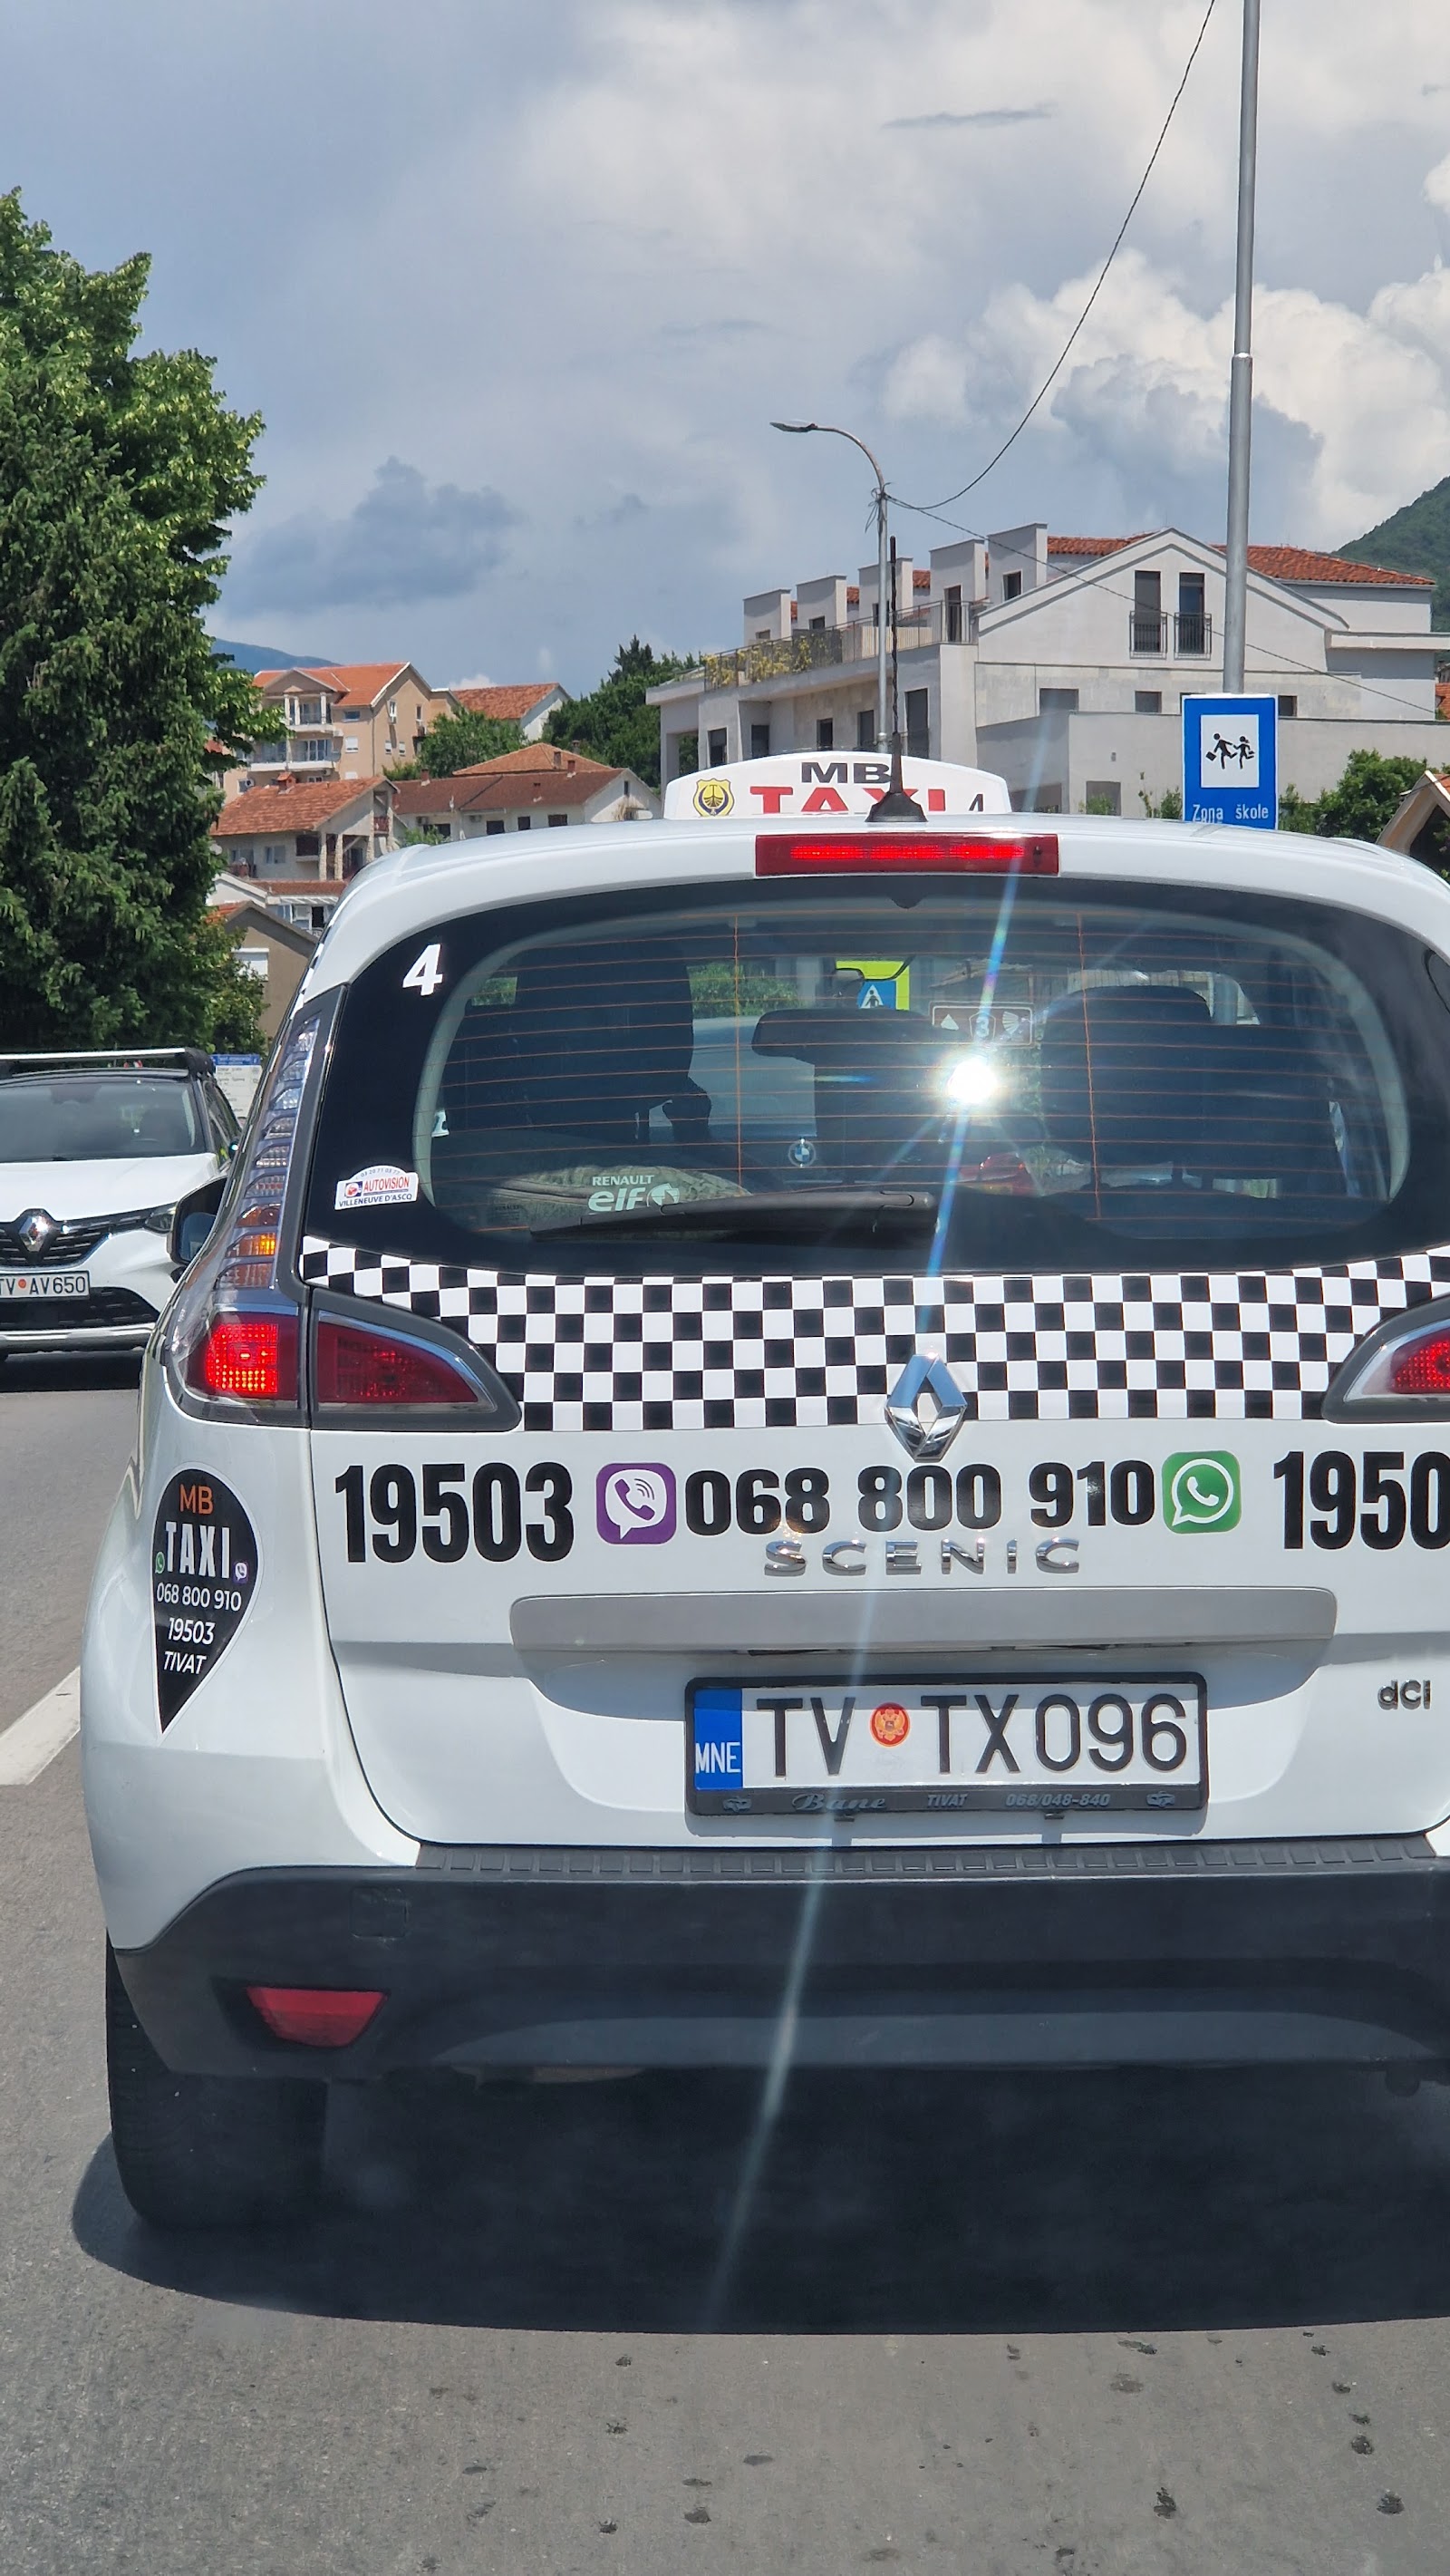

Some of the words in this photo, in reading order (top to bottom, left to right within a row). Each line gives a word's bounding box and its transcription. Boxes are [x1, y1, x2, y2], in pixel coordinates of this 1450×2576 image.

[801, 762, 891, 784] MB
[1193, 804, 1223, 822] Zona
[1235, 803, 1269, 819] škole
[402, 944, 442, 995] 4
[363, 1177, 410, 1193] AUTOVISION
[592, 1175, 654, 1186] RENAULT
[339, 1196, 383, 1207] VILLENEUVE
[384, 1193, 412, 1202] D'ASCQ
[588, 1187, 645, 1212] elf
[179, 1484, 214, 1515] MB
[335, 1461, 575, 1564] 19503
[685, 1467, 831, 1535] 068
[858, 1463, 1001, 1532] 800
[1030, 1459, 1155, 1528] 910
[1273, 1450, 1450, 1550] 1950
[166, 1521, 230, 1579] TAXI
[764, 1539, 1079, 1577] SCENIC
[157, 1583, 179, 1604] 068
[182, 1586, 210, 1608] 800
[214, 1590, 241, 1612] 910
[168, 1618, 216, 1645] 19503
[163, 1651, 207, 1675] TIVAT
[757, 1697, 856, 1777] TV
[921, 1692, 1187, 1775] TX096
[695, 1741, 740, 1773] MNE
[792, 1793, 886, 1810] Bane
[927, 1793, 969, 1807] TIVAT
[1005, 1793, 1111, 1807] 068/048-840
